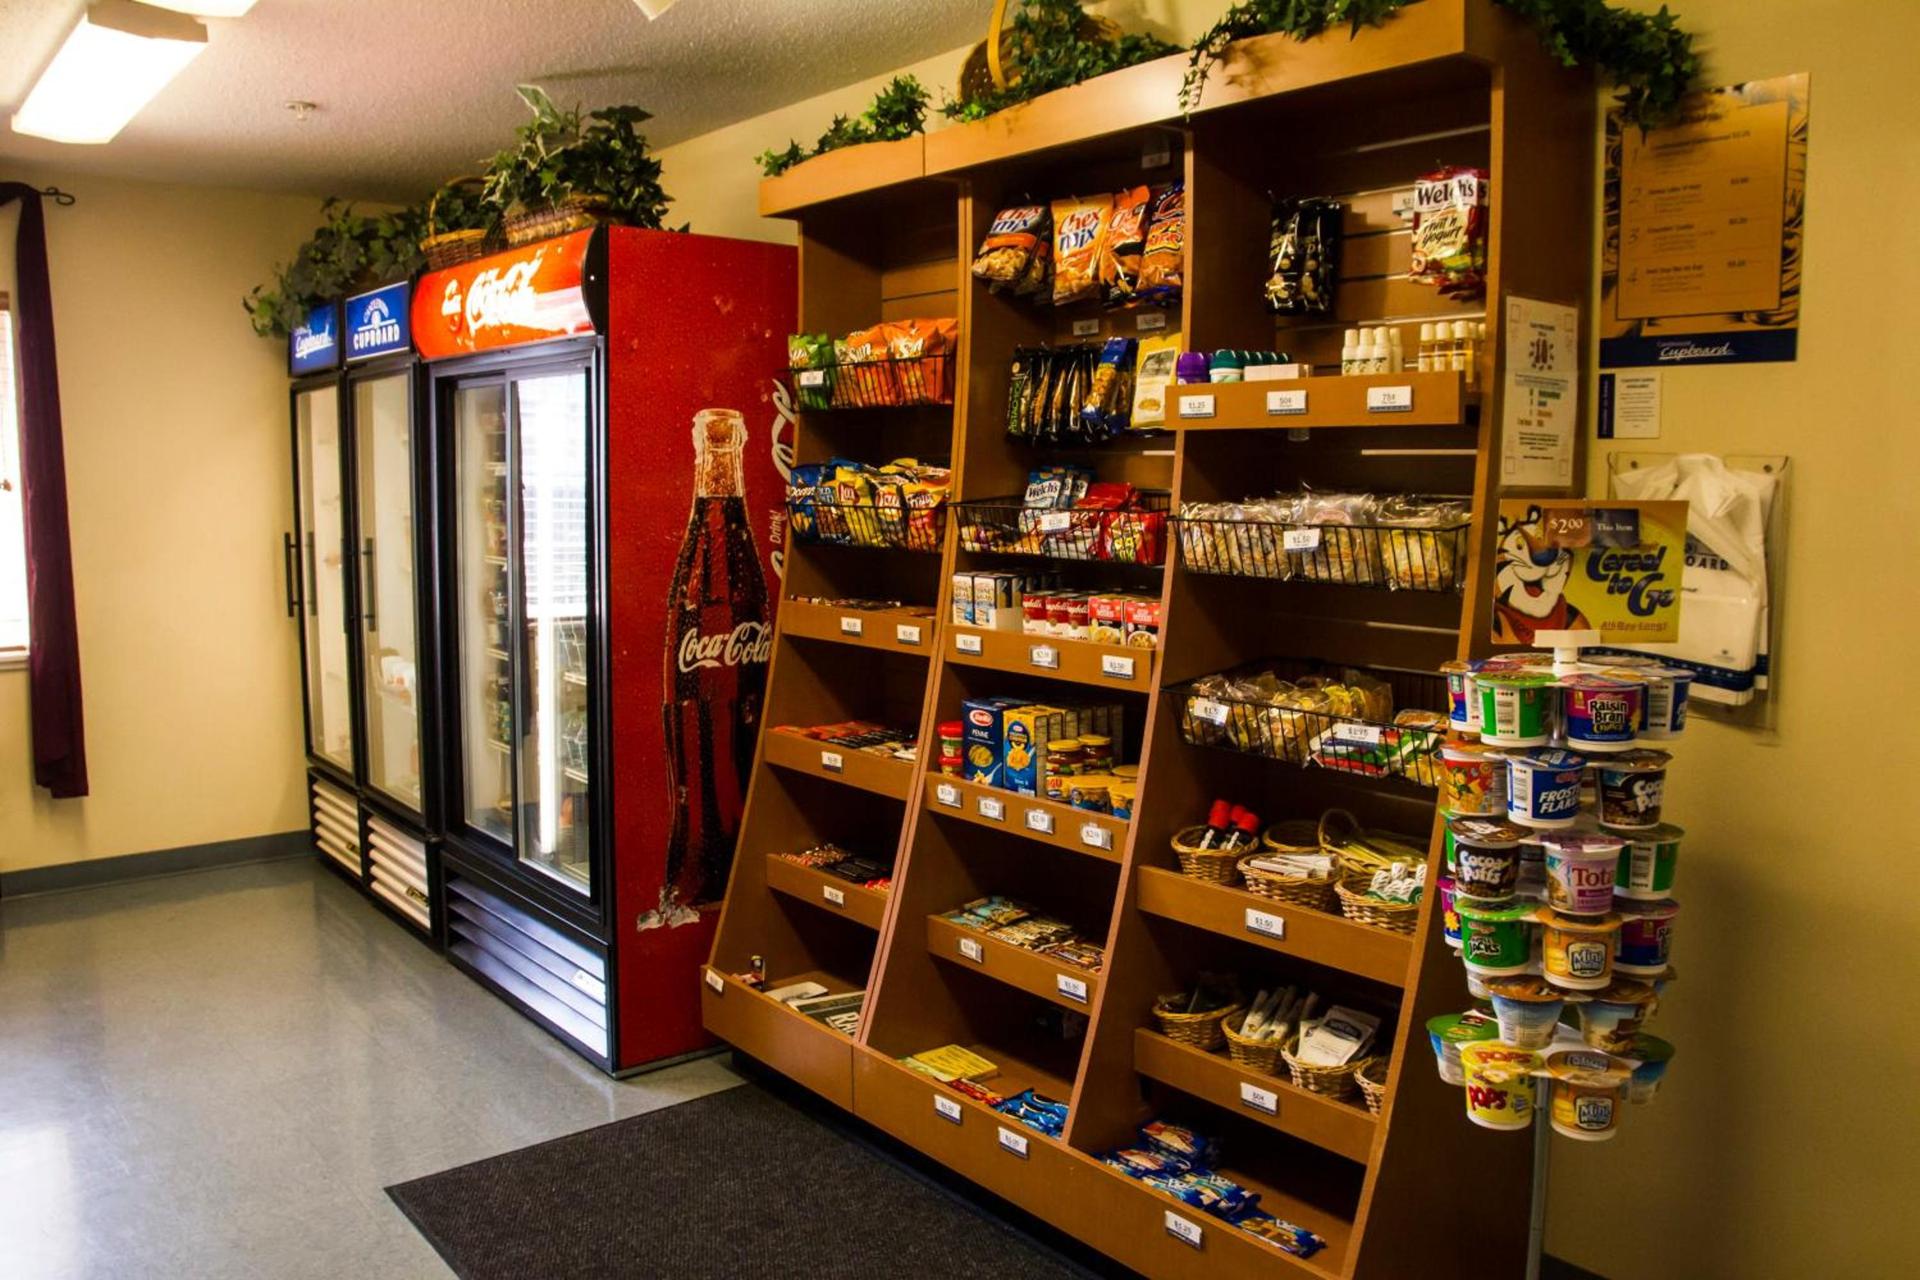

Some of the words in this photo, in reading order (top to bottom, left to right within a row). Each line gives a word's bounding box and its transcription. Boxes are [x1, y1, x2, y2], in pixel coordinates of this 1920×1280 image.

[1058, 207, 1100, 235] Chex
[1596, 522, 1613, 531] This
[1615, 522, 1633, 532] Item
[1586, 545, 1667, 582] Cereal
[1685, 556, 1729, 571] OARD
[1606, 573, 1634, 595] to
[1627, 572, 1676, 617] Go
[678, 621, 772, 673] Coca-Cola
[1589, 700, 1628, 713] Raisin
[1594, 711, 1624, 724] Bran
[1538, 785, 1580, 804] FROST
[1459, 850, 1504, 868] Cocoa
[1463, 866, 1500, 885] Puffs
